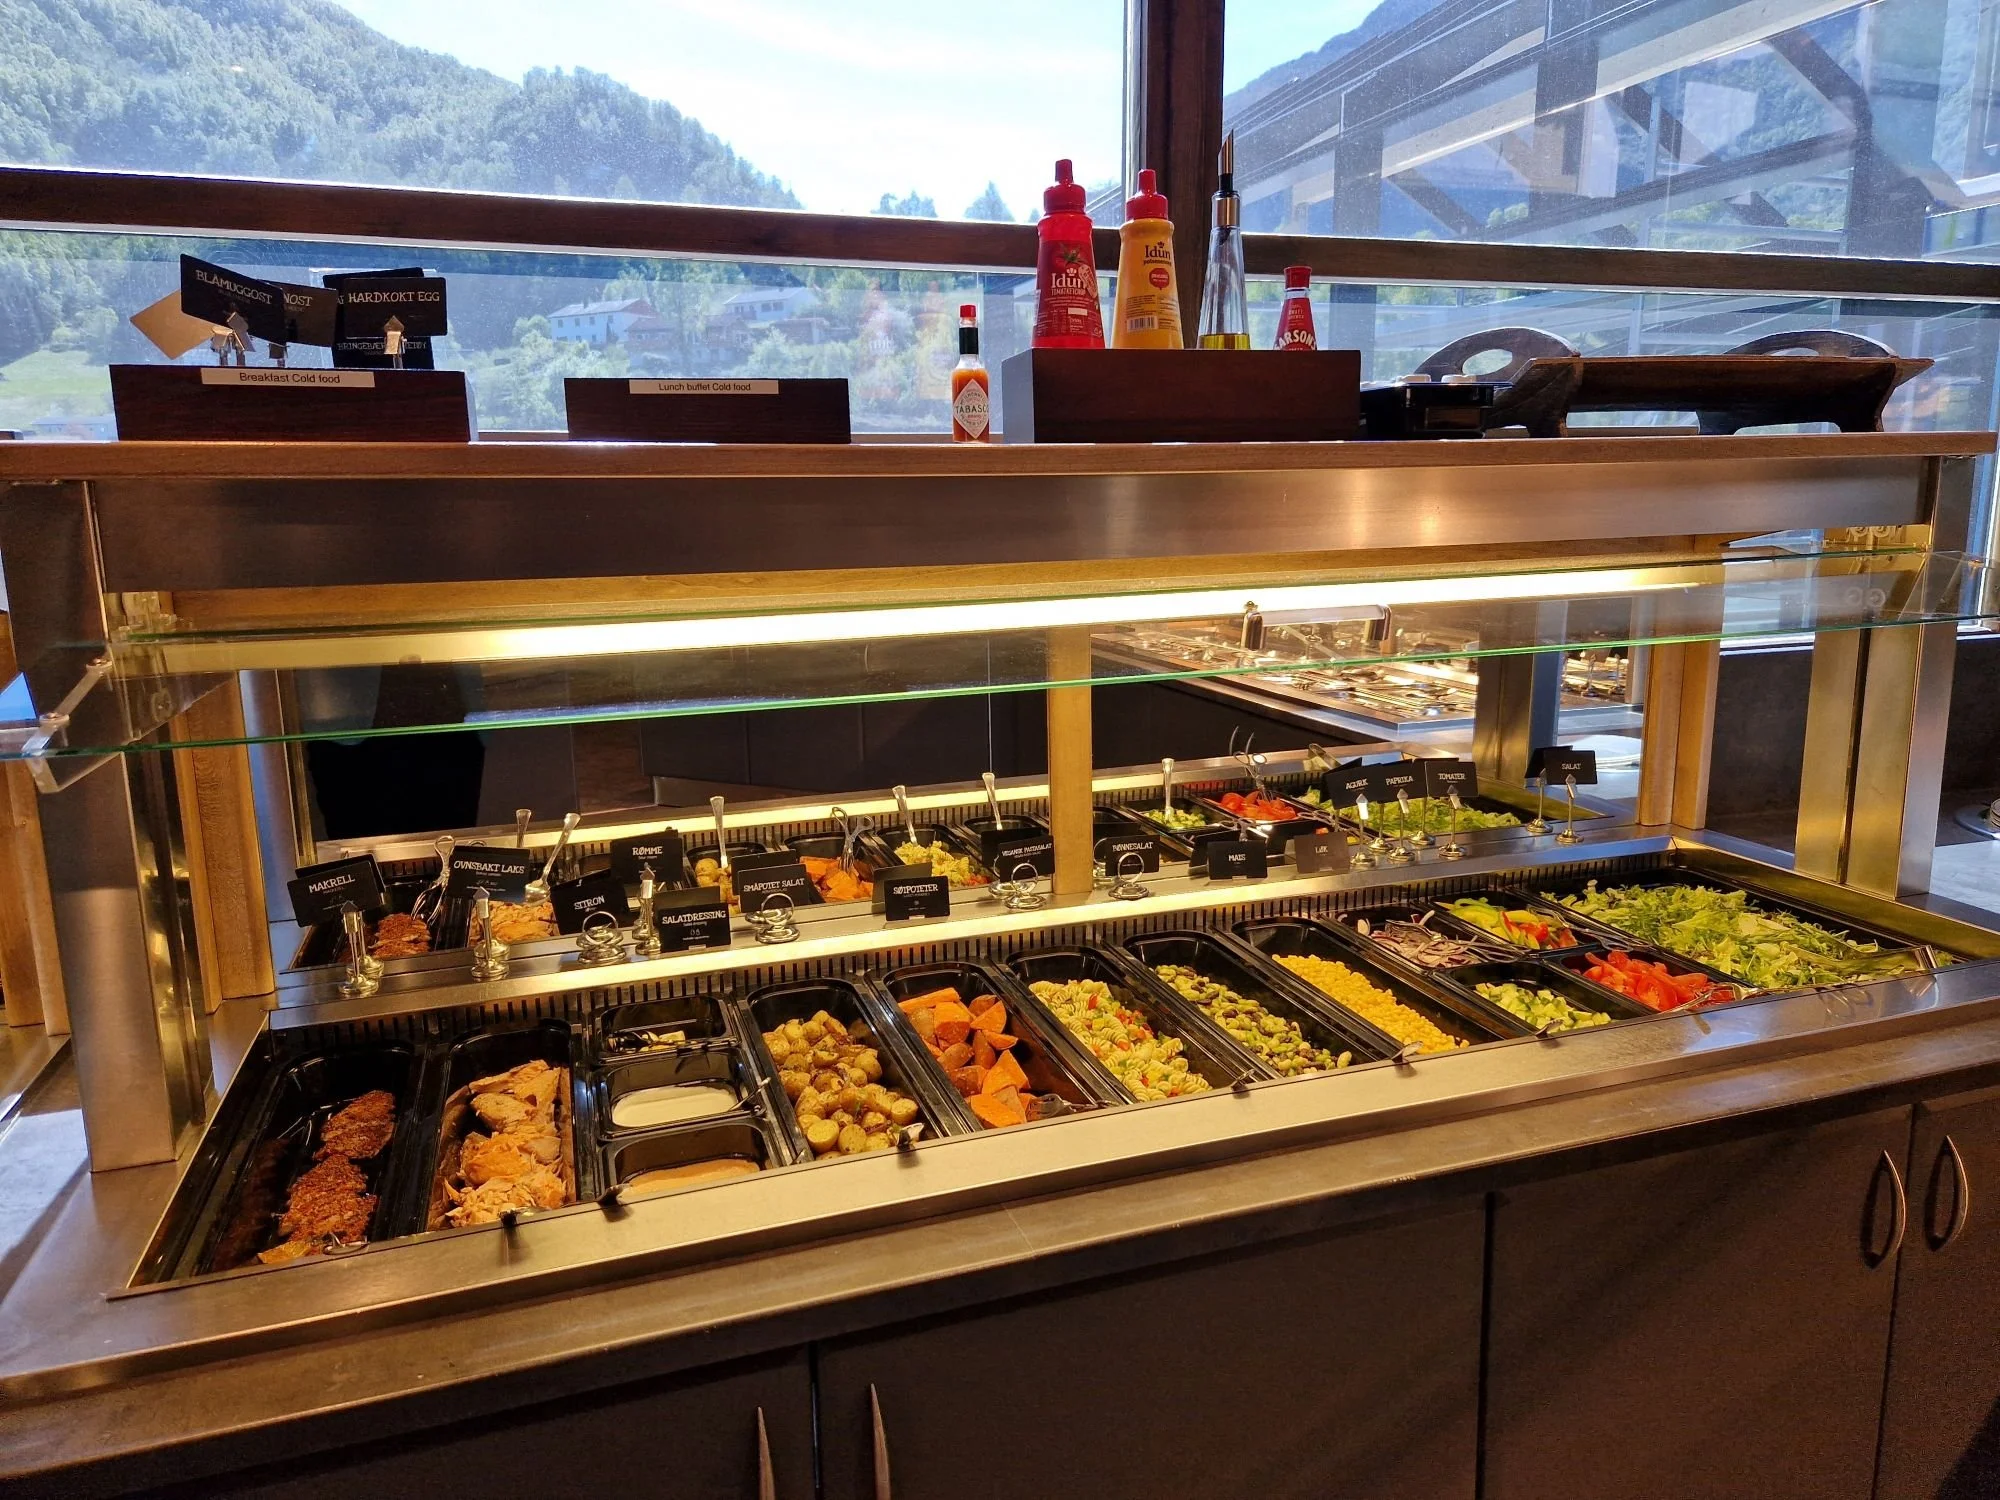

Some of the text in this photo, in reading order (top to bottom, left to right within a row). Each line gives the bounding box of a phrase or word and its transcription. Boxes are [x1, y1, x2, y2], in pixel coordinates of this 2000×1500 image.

[1145, 245, 1171, 260] Idun
[1051, 272, 1087, 289] Idun
[283, 292, 313, 307] NOST
[348, 291, 415, 303] HARDKOKT
[418, 291, 440, 302] EGG
[239, 372, 341, 384] Breakfast Cold food
[658, 383, 751, 391] Lunch buffet Cold food
[1345, 778, 1369, 790] AGURK
[1386, 775, 1414, 786] PAPRIKA
[632, 846, 663, 856] RØMME
[1112, 841, 1154, 851] BØNNESALAT
[1228, 853, 1246, 861] MAIS
[453, 860, 501, 873] OVNSBAKT
[501, 865, 525, 874] LAKS
[308, 874, 356, 893] MAKRELL
[781, 878, 805, 887] SALAT
[893, 884, 939, 895] SØTPOTETER
[574, 896, 606, 910] SITRON
[662, 910, 727, 924] SALATDRESSING
